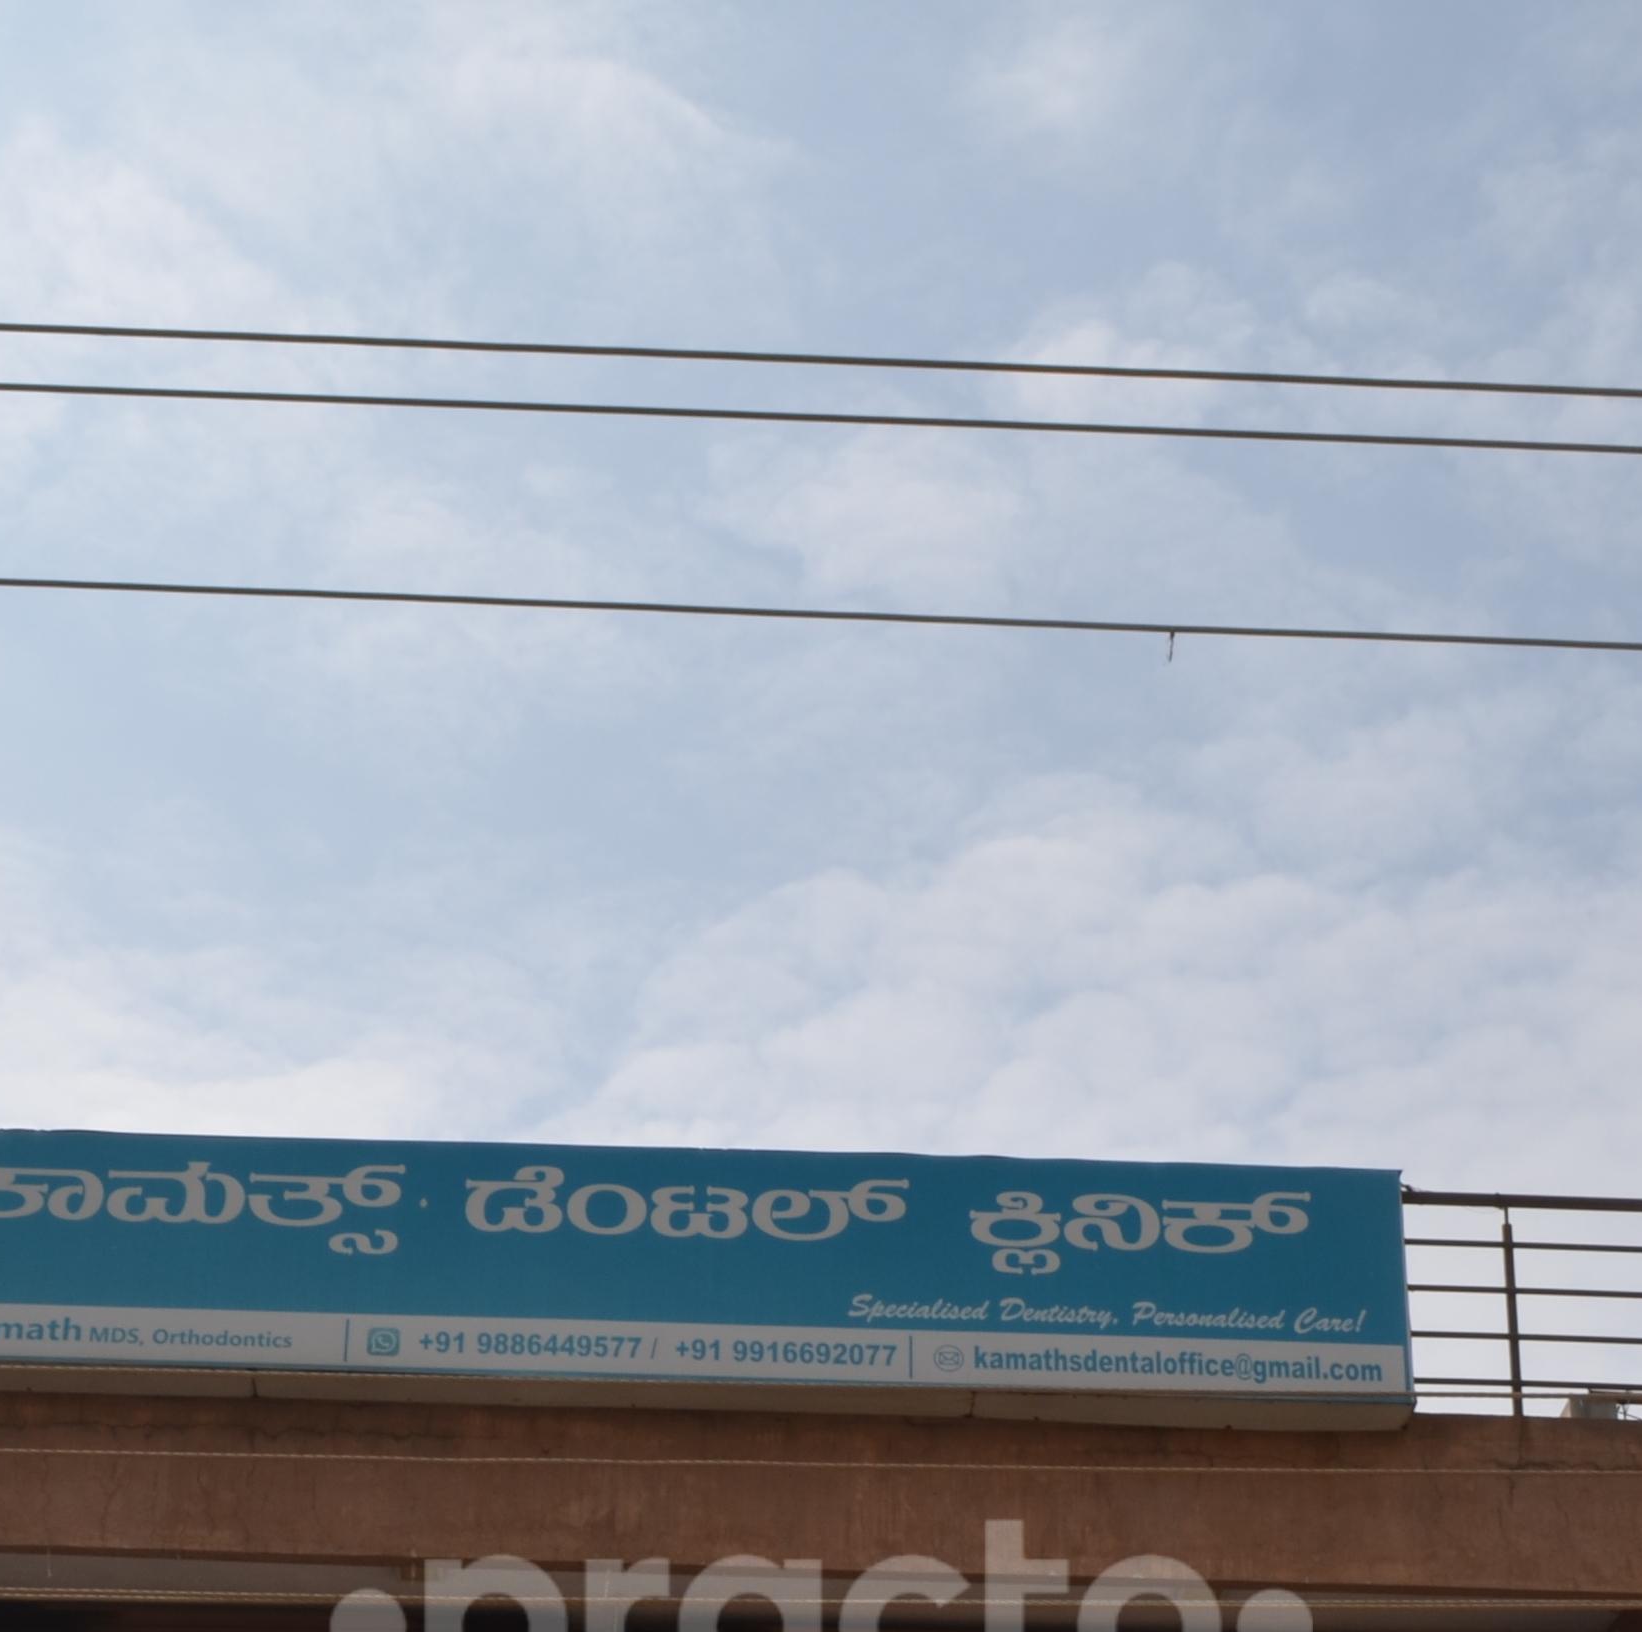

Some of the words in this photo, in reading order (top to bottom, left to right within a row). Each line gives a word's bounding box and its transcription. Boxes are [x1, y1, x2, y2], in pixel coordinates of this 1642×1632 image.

[464, 1164, 910, 1242] ಡೆಂಟಲ್
[968, 1190, 1312, 1275] ಕ್ಲಿನಿಕ್
[847, 1293, 989, 1322] Specialised
[1132, 1301, 1286, 1331] Personalised
[1294, 1305, 1368, 1335] Care!
[89, 1326, 145, 1347] MDS,
[152, 1328, 294, 1350] Orthodontics
[418, 1331, 466, 1355] +91
[476, 1331, 644, 1360] 9886449577
[675, 1338, 722, 1362] +91
[732, 1339, 899, 1367] 9916692077
[973, 1345, 1384, 1384] kamathsdentaloffice@gmail.com
